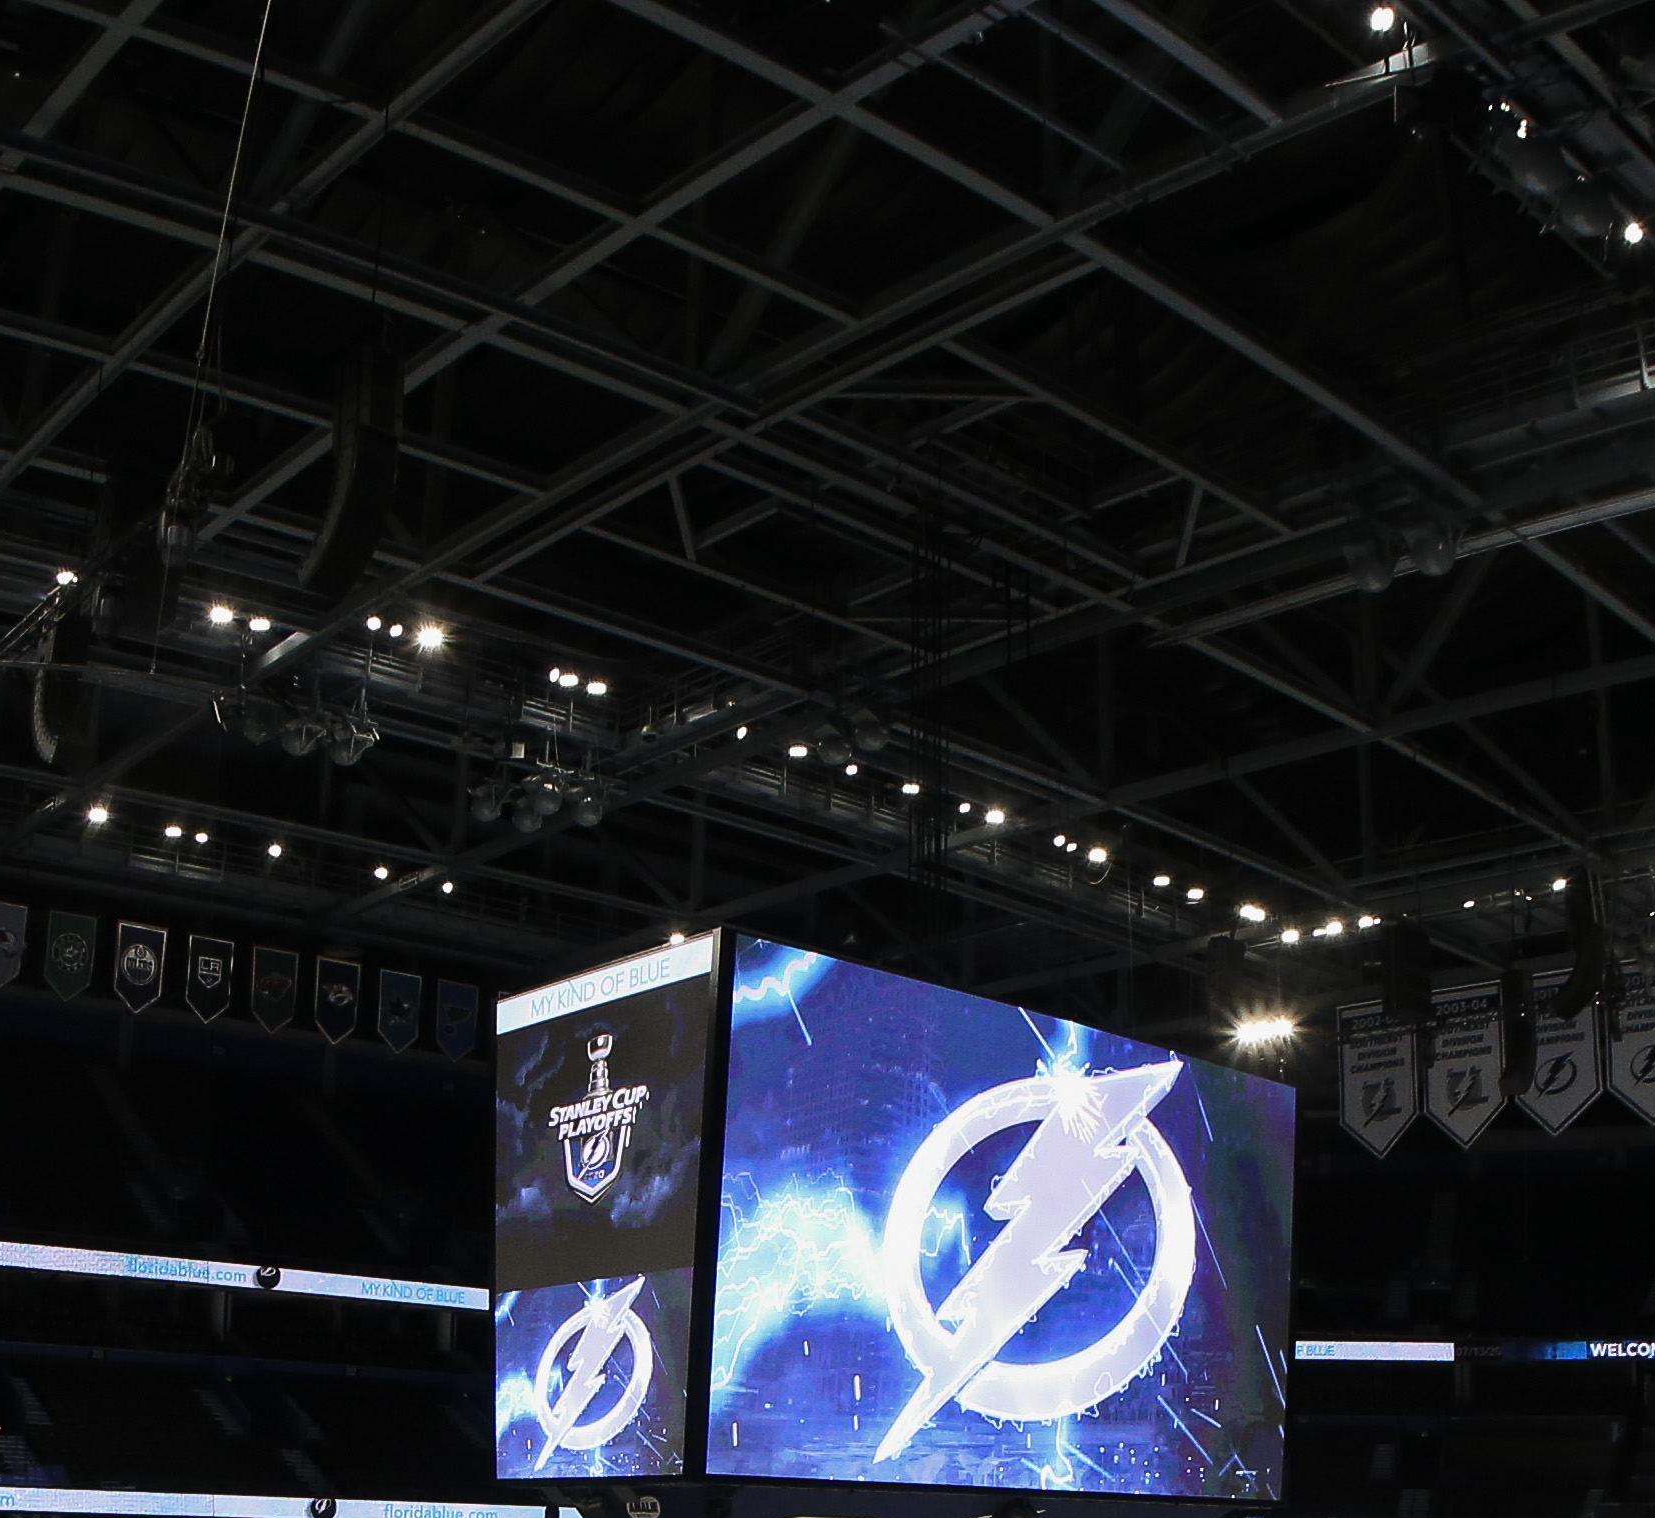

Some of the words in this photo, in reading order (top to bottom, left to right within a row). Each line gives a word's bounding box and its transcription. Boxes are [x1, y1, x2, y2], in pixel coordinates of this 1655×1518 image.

[530, 995, 554, 1019] MY
[557, 980, 595, 1006] KIND
[600, 971, 625, 997] OF
[629, 957, 671, 989] BLUE
[1435, 999, 1489, 1017] 2003-04
[1440, 1033, 1484, 1048] DIVISION
[1358, 1045, 1398, 1060] DIVISION
[1350, 1058, 1405, 1075] CHAMPIONS
[549, 1095, 612, 1128] STANLEY
[612, 1085, 649, 1111] CUP
[558, 1108, 634, 1141] PLAYOFFS
[361, 1282, 381, 1297] MY
[383, 1279, 413, 1300] KIND
[415, 1287, 434, 1301] OF
[436, 1289, 466, 1304] BLUE
[1306, 1346, 1335, 1358] BLUE
